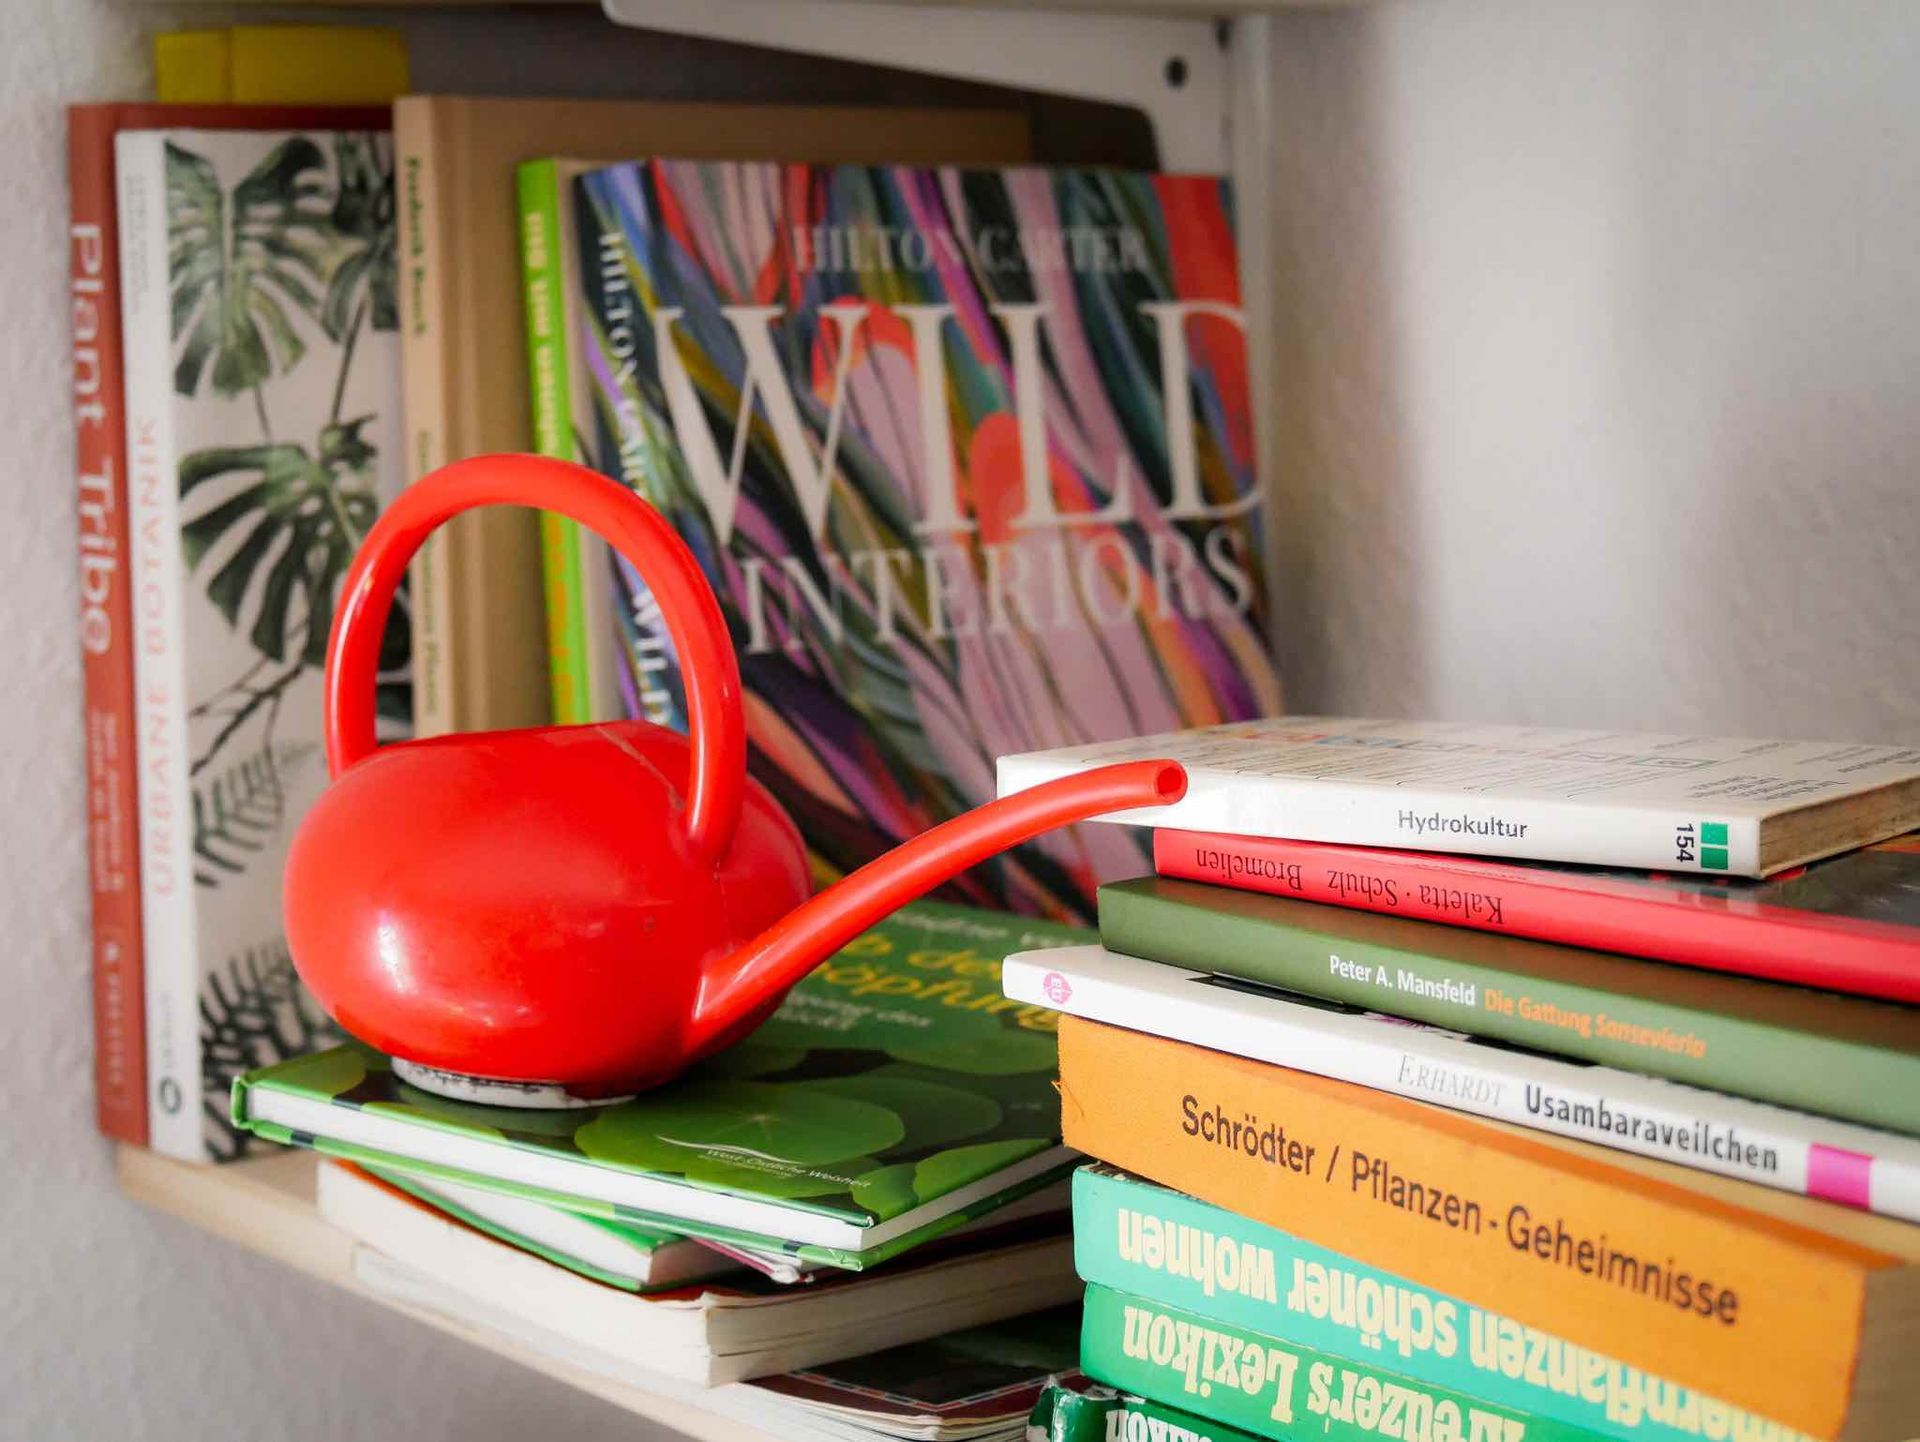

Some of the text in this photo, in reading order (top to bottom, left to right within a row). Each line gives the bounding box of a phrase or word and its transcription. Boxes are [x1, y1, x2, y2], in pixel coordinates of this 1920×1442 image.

[793, 226, 970, 273] HILTON
[600, 232, 637, 381] HILTON
[71, 224, 117, 656] Plant Tribe
[655, 299, 1263, 546] WILD
[738, 527, 1253, 652] INTERIORS
[136, 418, 177, 895] URBANE BOTANIK
[1196, 847, 1303, 892] Bromelien
[1397, 809, 1530, 839] Hydrokultur
[1675, 822, 1695, 863] 154
[1327, 869, 1399, 907] Schulz
[1420, 885, 1505, 925] Kaletta
[1329, 955, 1372, 984] Peter
[1375, 965, 1393, 989] A.
[1397, 969, 1476, 1007] Mansfeld
[1484, 988, 1515, 1015] Die
[1518, 996, 1593, 1039] Gattung
[1180, 1094, 1316, 1177] Schrödter
[1397, 1053, 1779, 1172] ERHARDT Usambaraveilchen
[1117, 1207, 1278, 1305] wohnen
[1287, 1257, 1459, 1358] schöner
[1121, 1304, 1299, 1425] Lexikon
